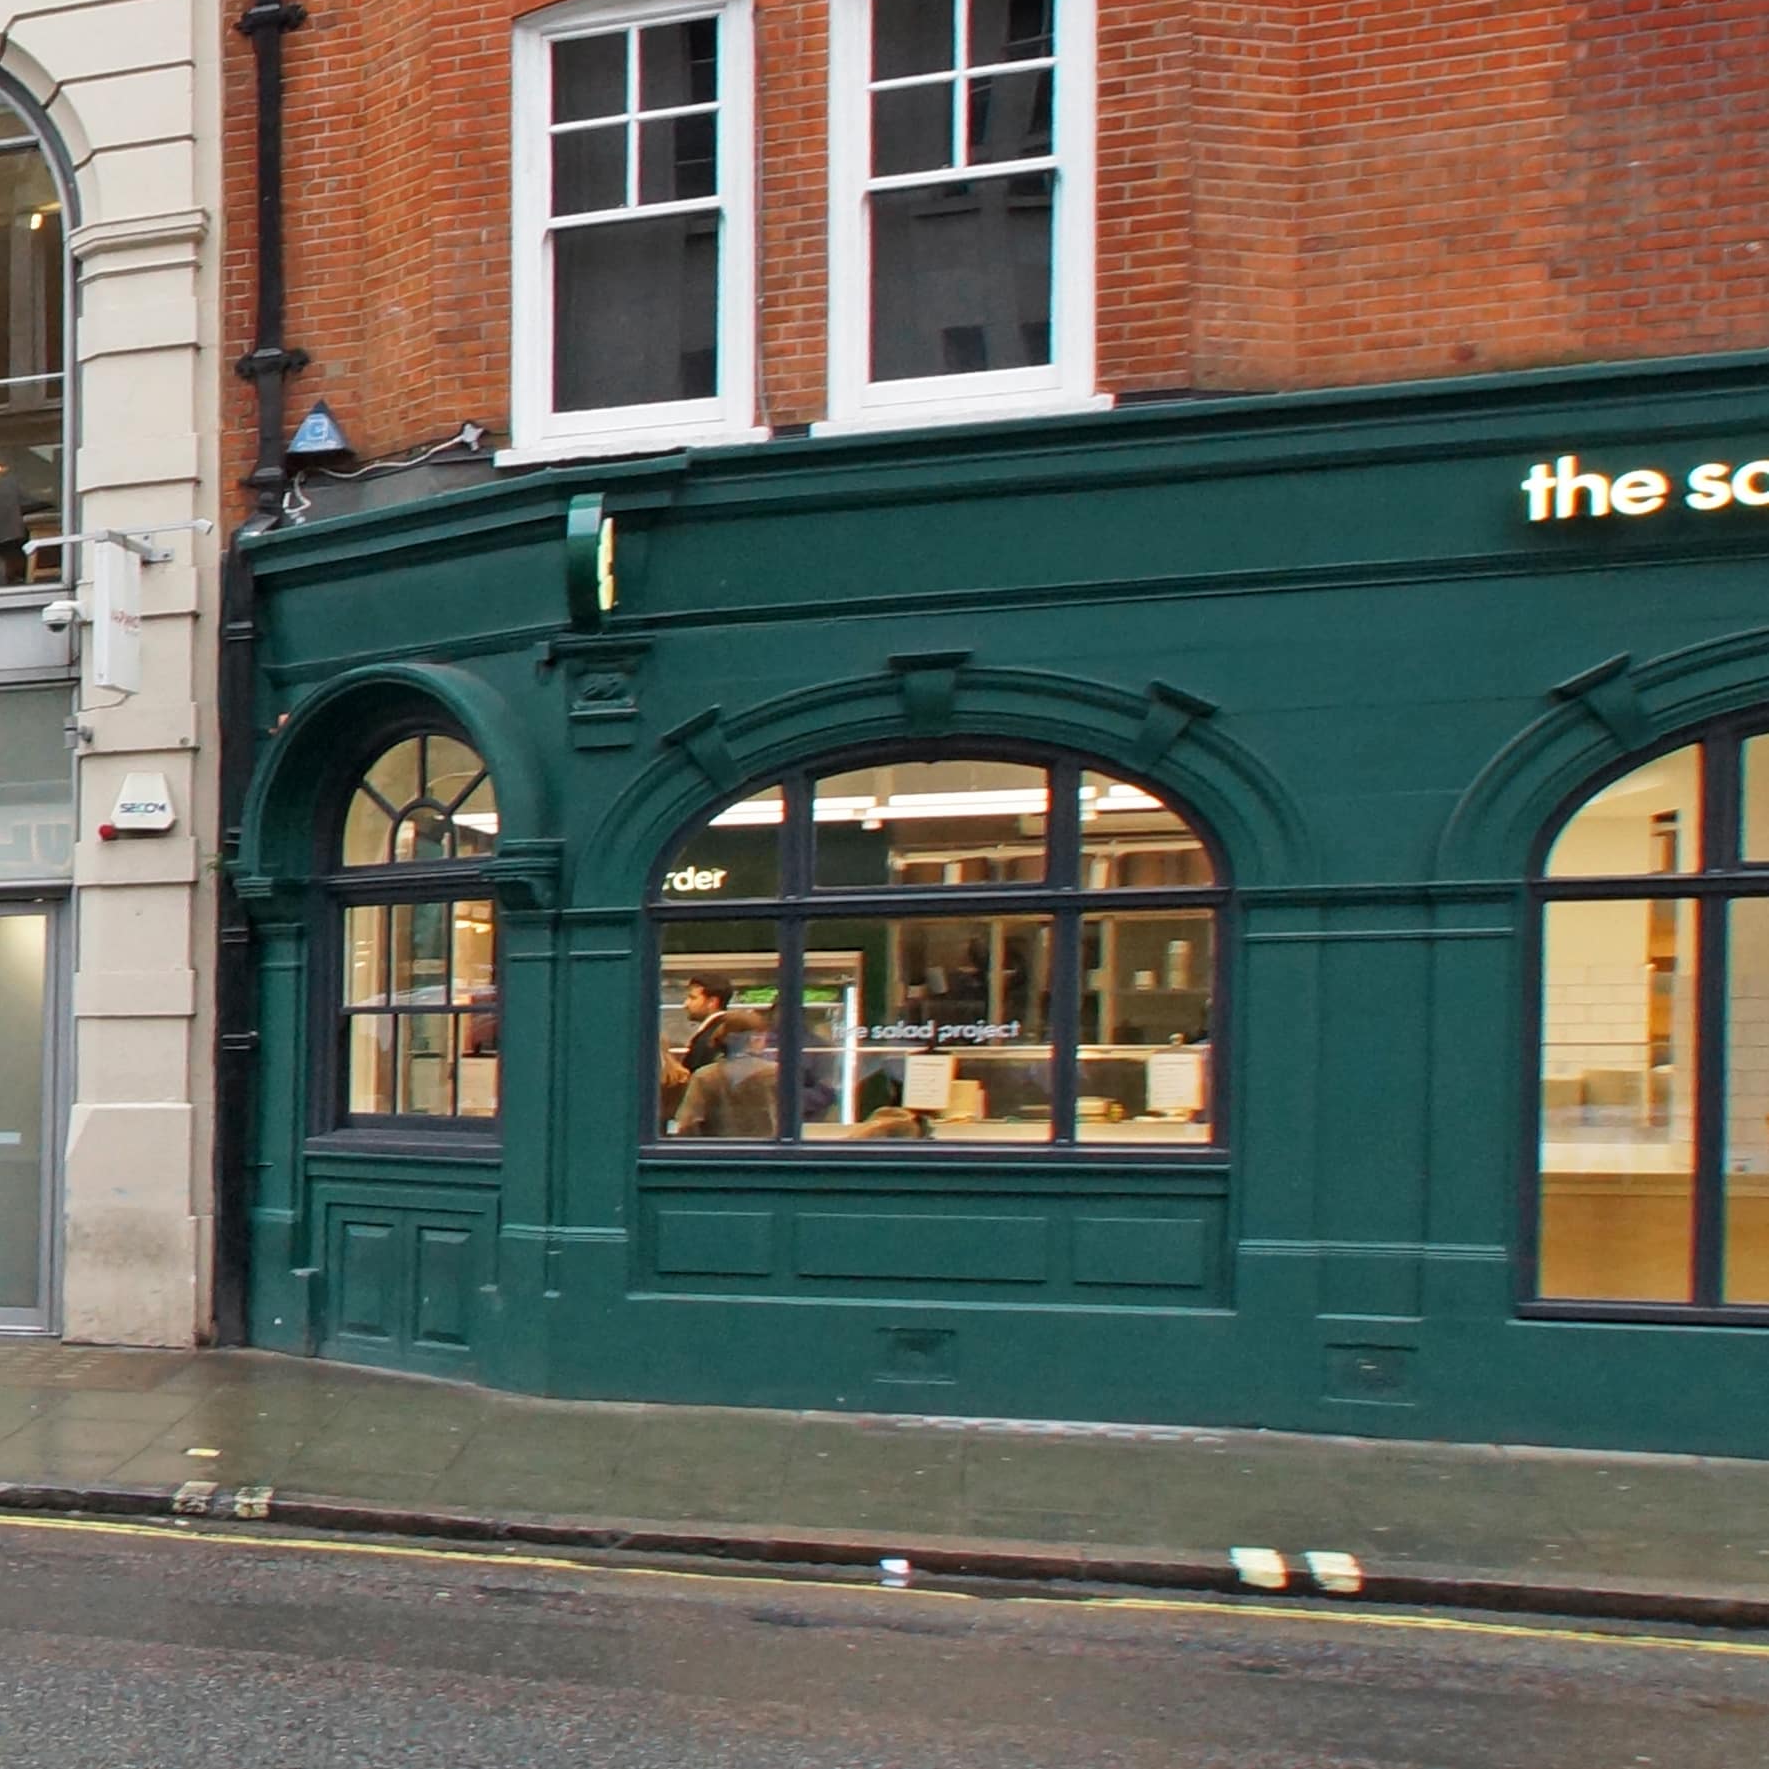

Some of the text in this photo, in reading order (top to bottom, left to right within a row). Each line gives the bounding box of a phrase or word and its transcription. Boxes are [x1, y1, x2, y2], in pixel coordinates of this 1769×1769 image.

[1521, 455, 1669, 521] the
[871, 1020, 936, 1040] salad
[937, 1020, 1021, 1043] project
